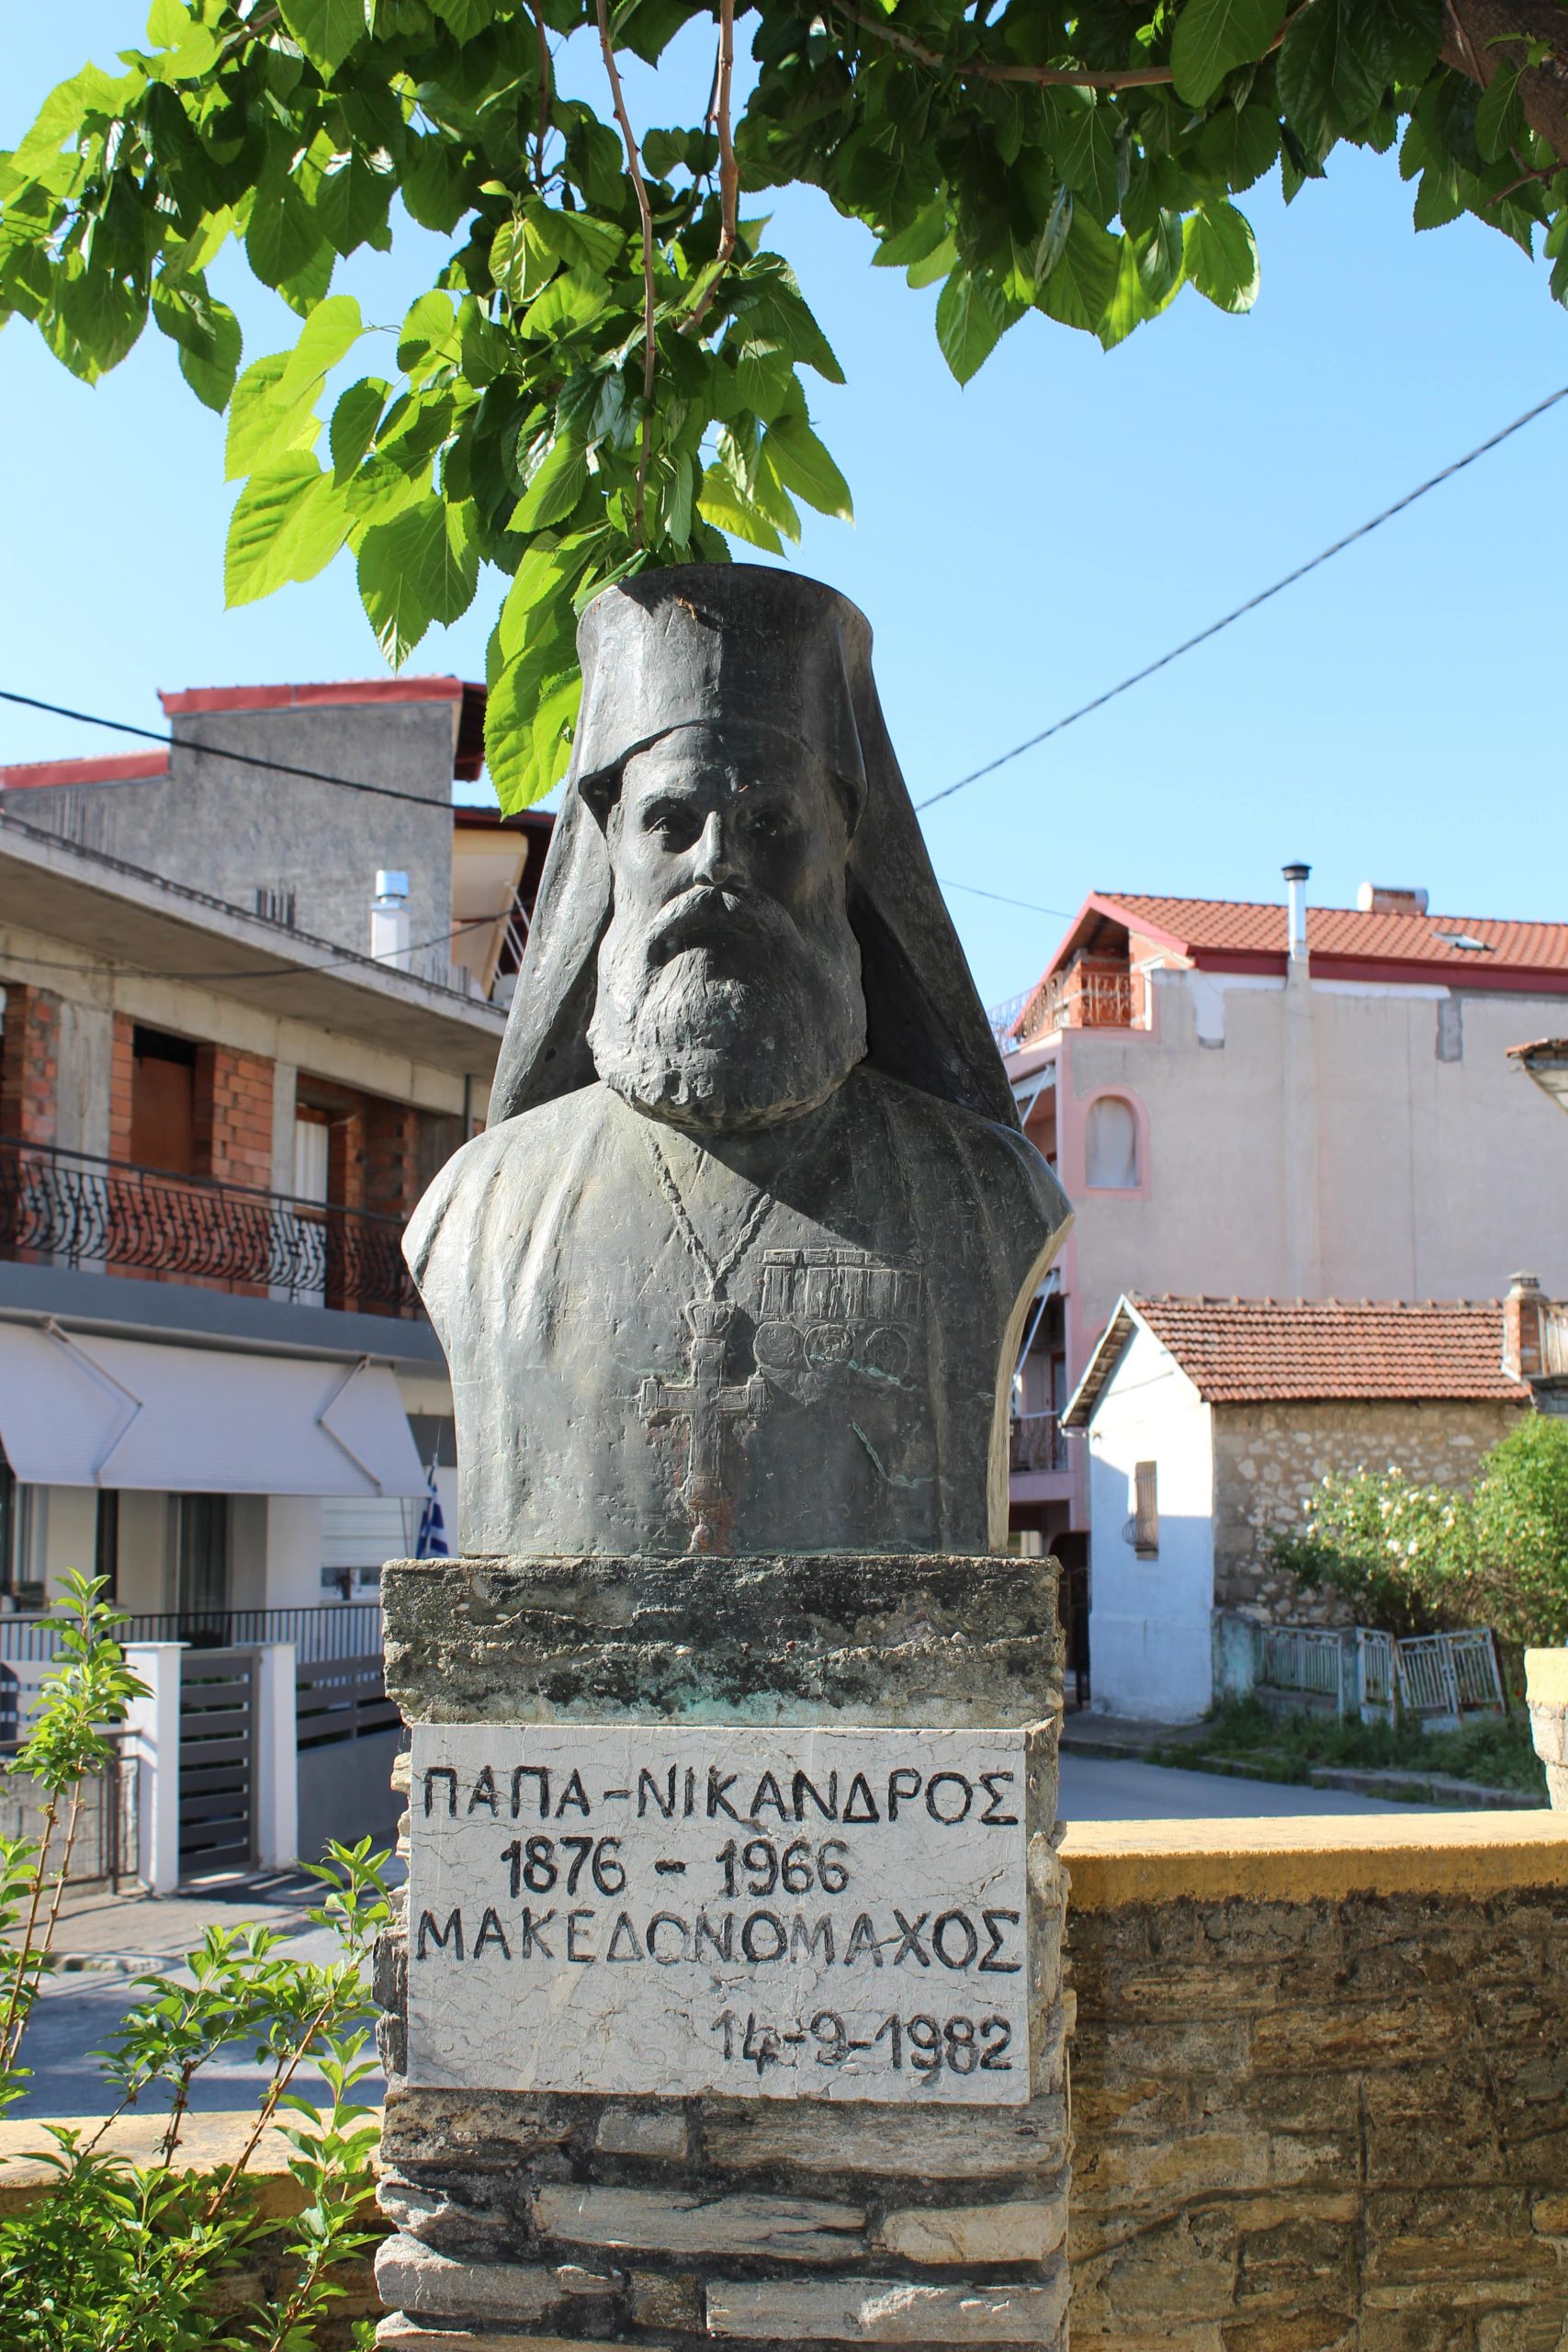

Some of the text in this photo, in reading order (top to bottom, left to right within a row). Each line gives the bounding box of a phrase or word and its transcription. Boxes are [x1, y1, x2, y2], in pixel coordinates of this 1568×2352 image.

[423, 1763, 1019, 1826] ΠΑΠΑ-ΝΙΚΑΝΔΡΟΣ
[501, 1836, 626, 1898] 1876
[715, 1838, 850, 1898] 1966
[416, 1905, 1022, 1973] ΜΑΚΕΔΟΝΟΜΑΧΟΣ
[711, 2008, 1013, 2075] 14-9-1982
